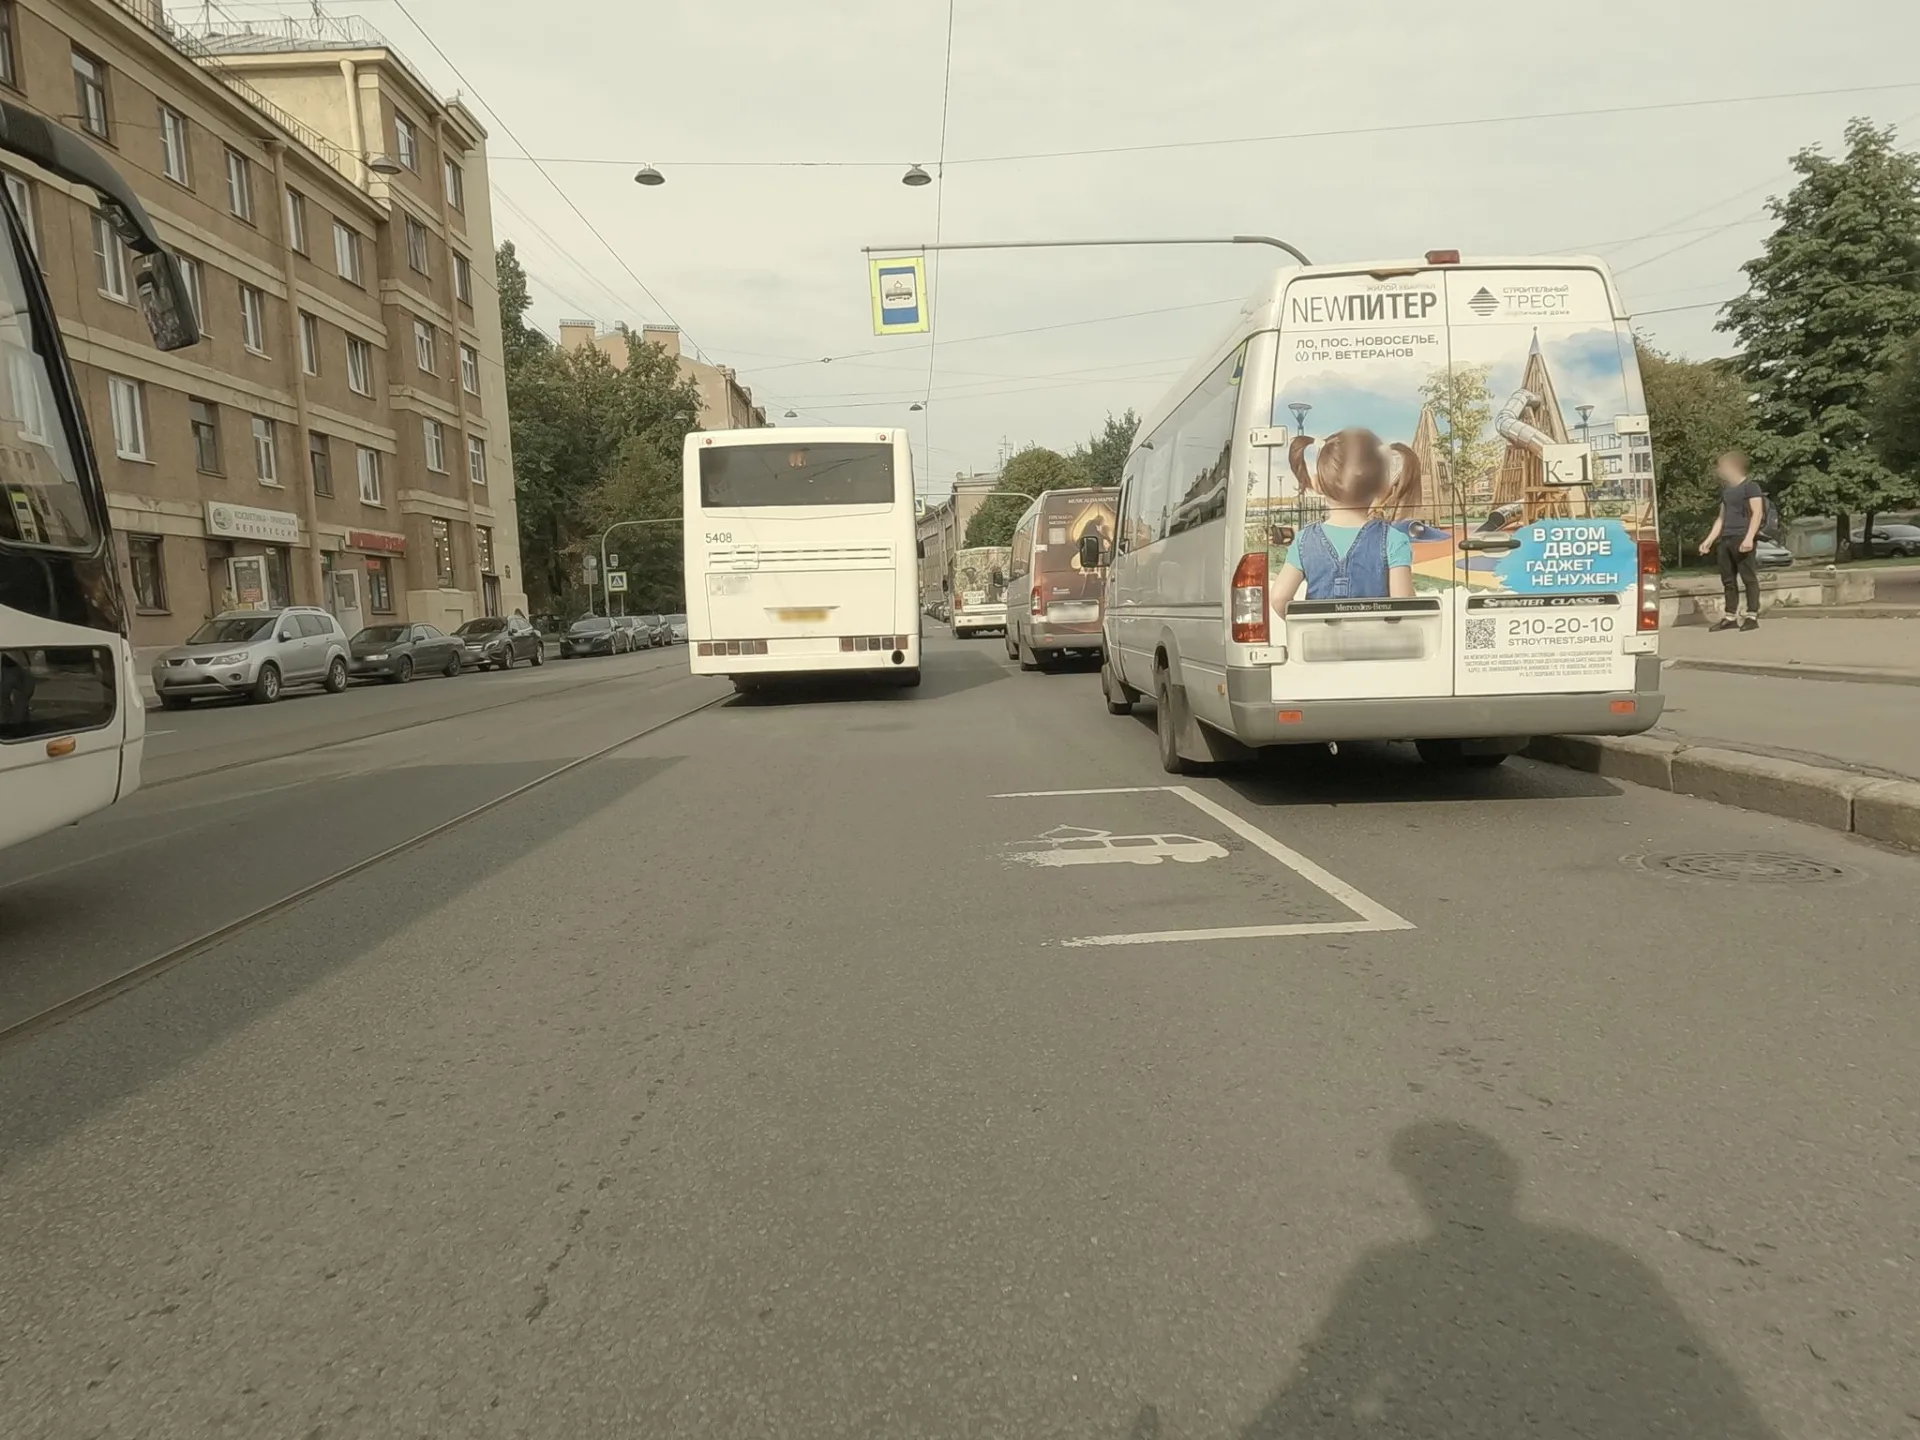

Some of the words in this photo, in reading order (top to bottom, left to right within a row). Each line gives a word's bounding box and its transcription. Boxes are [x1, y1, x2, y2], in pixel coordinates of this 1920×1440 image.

[1366, 283, 1398, 292] ЖИЛОЙ
[1502, 284, 1569, 294] СТРОИТЕЛЬНЫЙ
[1292, 291, 1437, 323] NEWПИТЕР
[1503, 294, 1569, 309] ТРЕСТ
[1296, 339, 1318, 350] ЛО,
[1320, 338, 1352, 348] ПОС.
[1355, 334, 1439, 347] НОВОСЕЛЬЕ,
[1312, 351, 1332, 361] ПР.
[1335, 348, 1414, 360] ВЕТЕРАНОВ
[1543, 452, 1592, 484] К-1
[705, 532, 732, 544] 5408
[1533, 528, 1546, 542] В
[1550, 526, 1606, 541] ЭТОМ
[1543, 541, 1612, 559] ДВОРЕ
[1526, 559, 1594, 574] ГАДЖЕТ
[1531, 574, 1554, 587] НЕ
[1557, 572, 1618, 586] НУЖЕН
[1335, 602, 1393, 612] Mercedes-Benz
[1550, 596, 1605, 606] CLASSIC
[1508, 616, 1614, 635] 210-20-10
[1507, 635, 1614, 647] STROYTREST.SPB.RU
